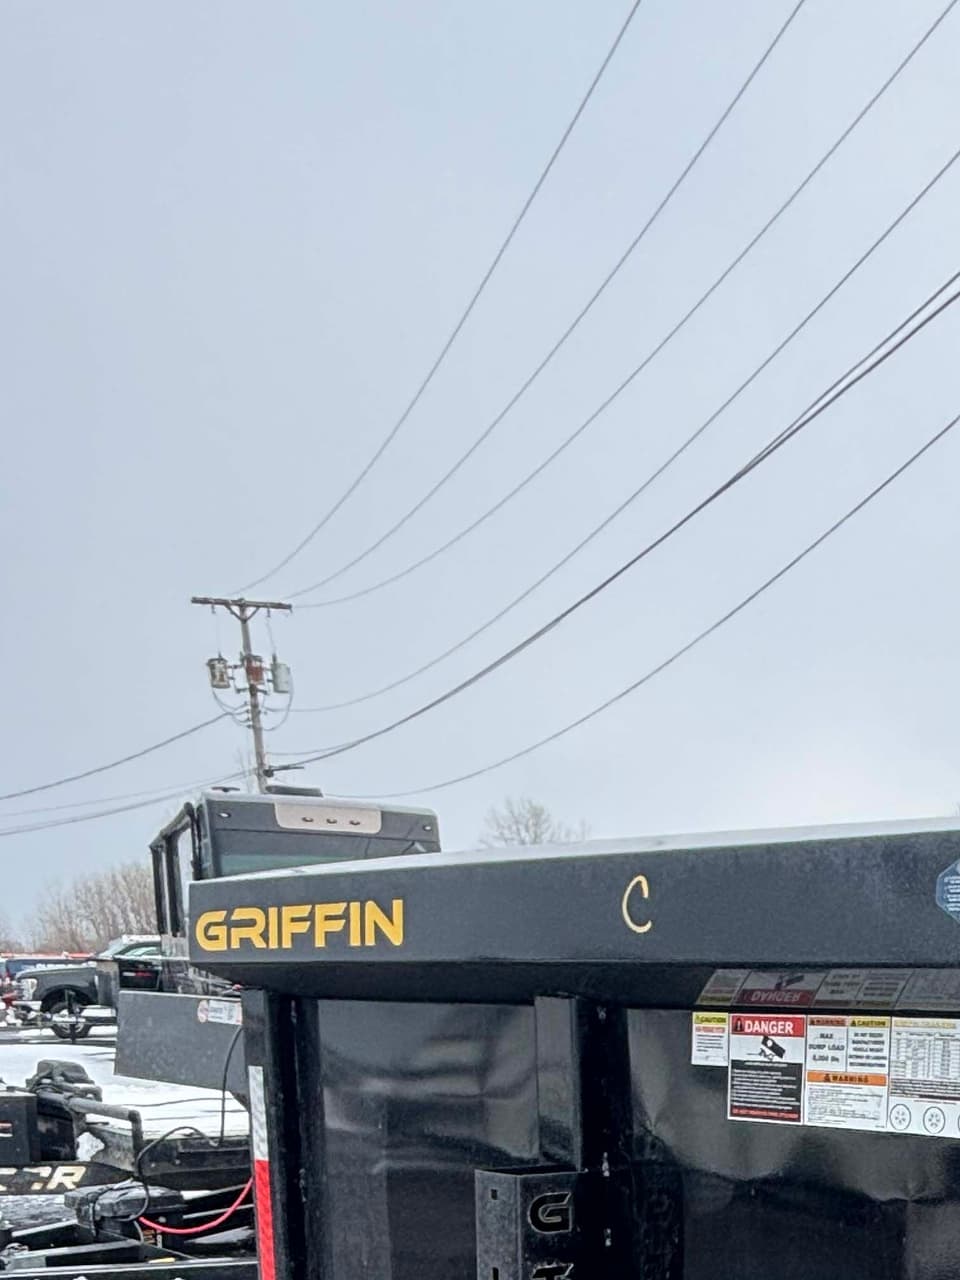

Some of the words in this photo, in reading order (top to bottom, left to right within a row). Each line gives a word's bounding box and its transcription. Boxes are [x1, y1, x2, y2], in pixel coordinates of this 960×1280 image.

[621, 873, 653, 933] C
[195, 899, 404, 952] GRIFFIN
[744, 1020, 794, 1035] DANGER
[832, 1074, 869, 1083] WARNING
